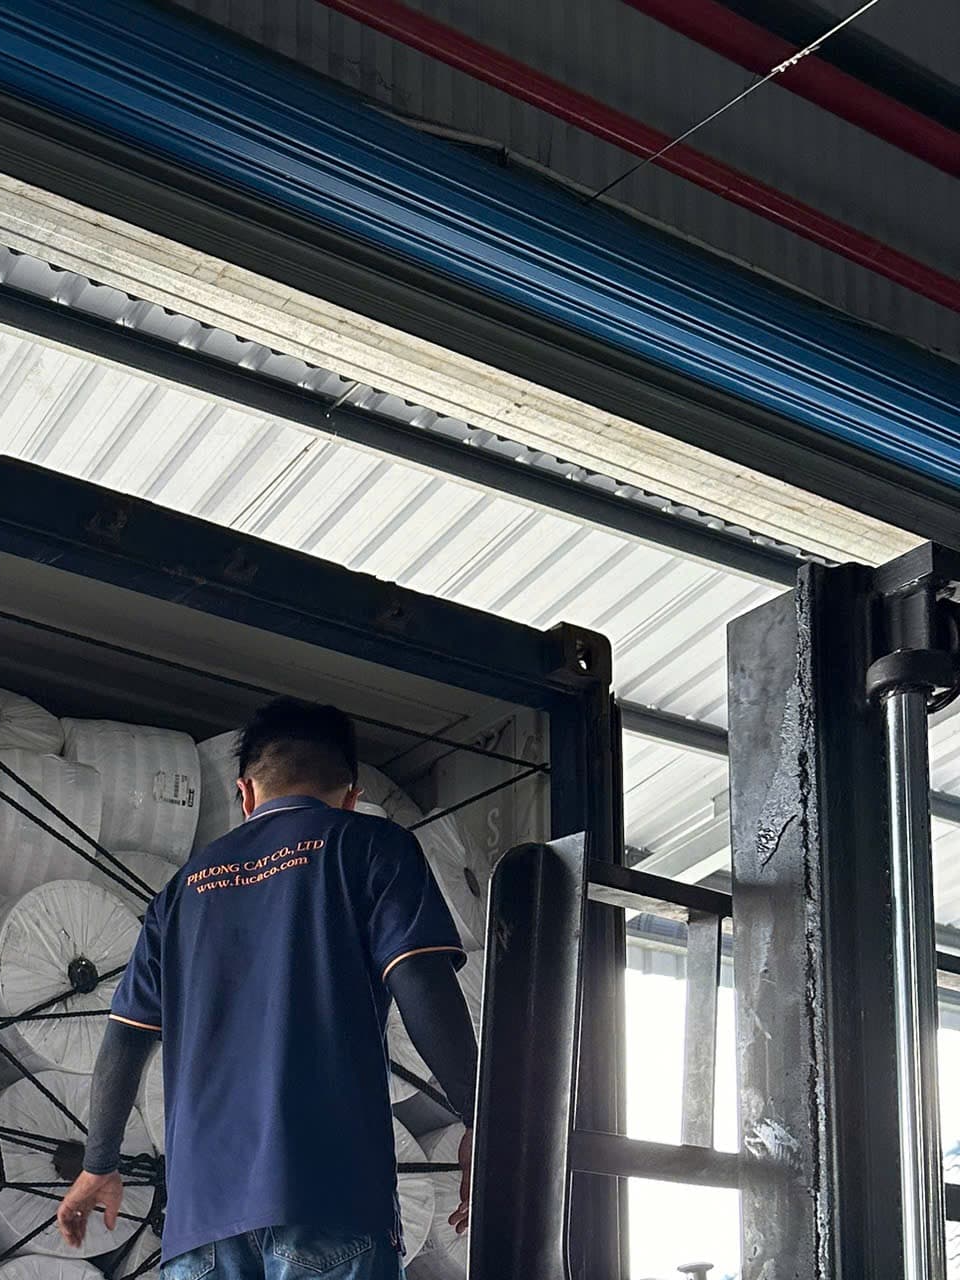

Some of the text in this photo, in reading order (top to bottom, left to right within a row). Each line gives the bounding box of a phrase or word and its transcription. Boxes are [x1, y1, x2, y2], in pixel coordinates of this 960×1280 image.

[187, 863, 240, 887] PHUONG
[243, 855, 271, 871] CAT
[296, 840, 325, 852] LTD
[196, 856, 308, 894] www.fucaco.com
